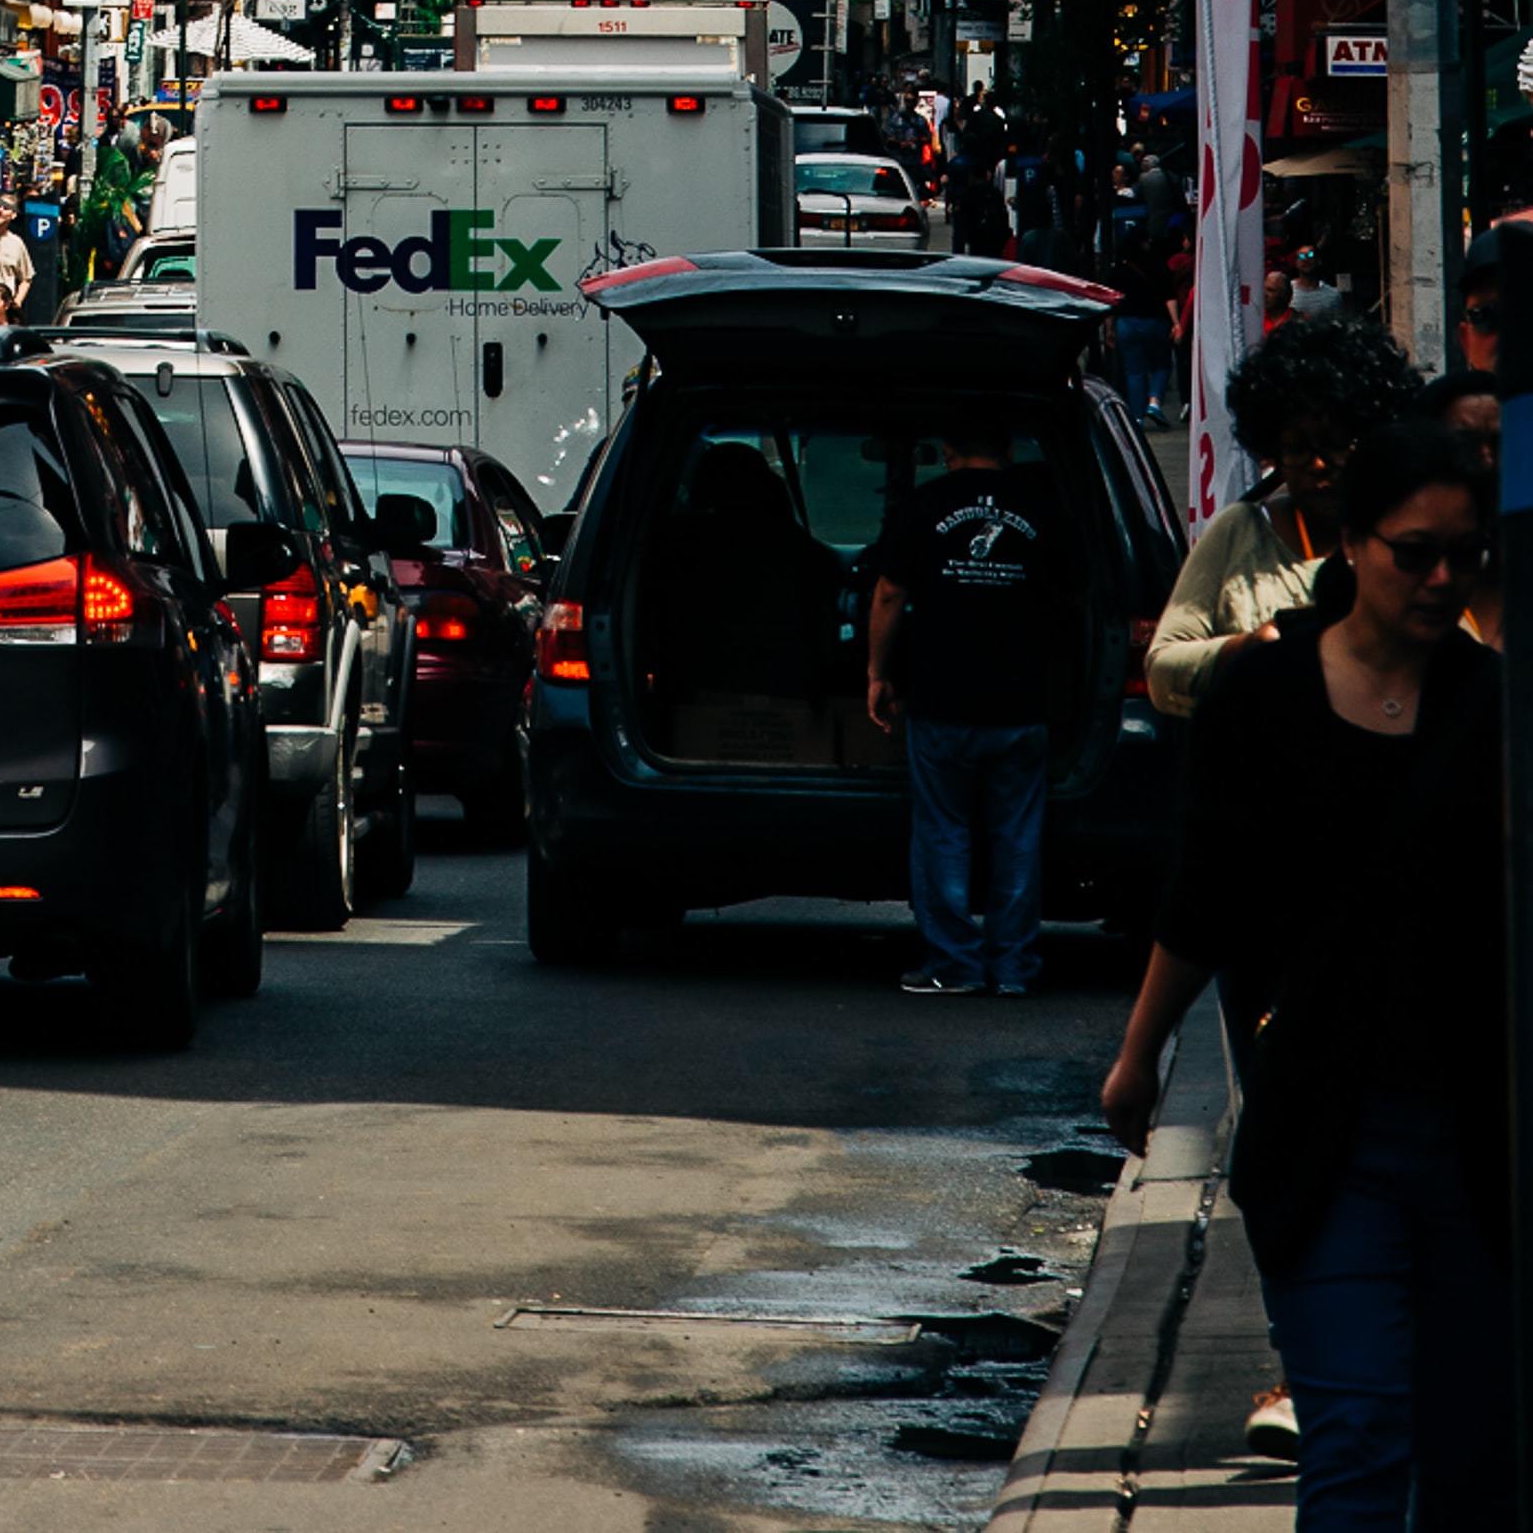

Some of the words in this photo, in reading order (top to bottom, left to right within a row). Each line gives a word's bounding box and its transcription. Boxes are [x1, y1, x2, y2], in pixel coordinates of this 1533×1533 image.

[598, 21, 627, 32] 1511
[1332, 41, 1387, 61] ATM
[582, 97, 631, 111] 304243
[38, 219, 50, 237] P
[294, 208, 562, 293] FedEx
[449, 299, 508, 317] Home
[513, 298, 588, 320] Delivery
[352, 404, 471, 427] fedex.com
